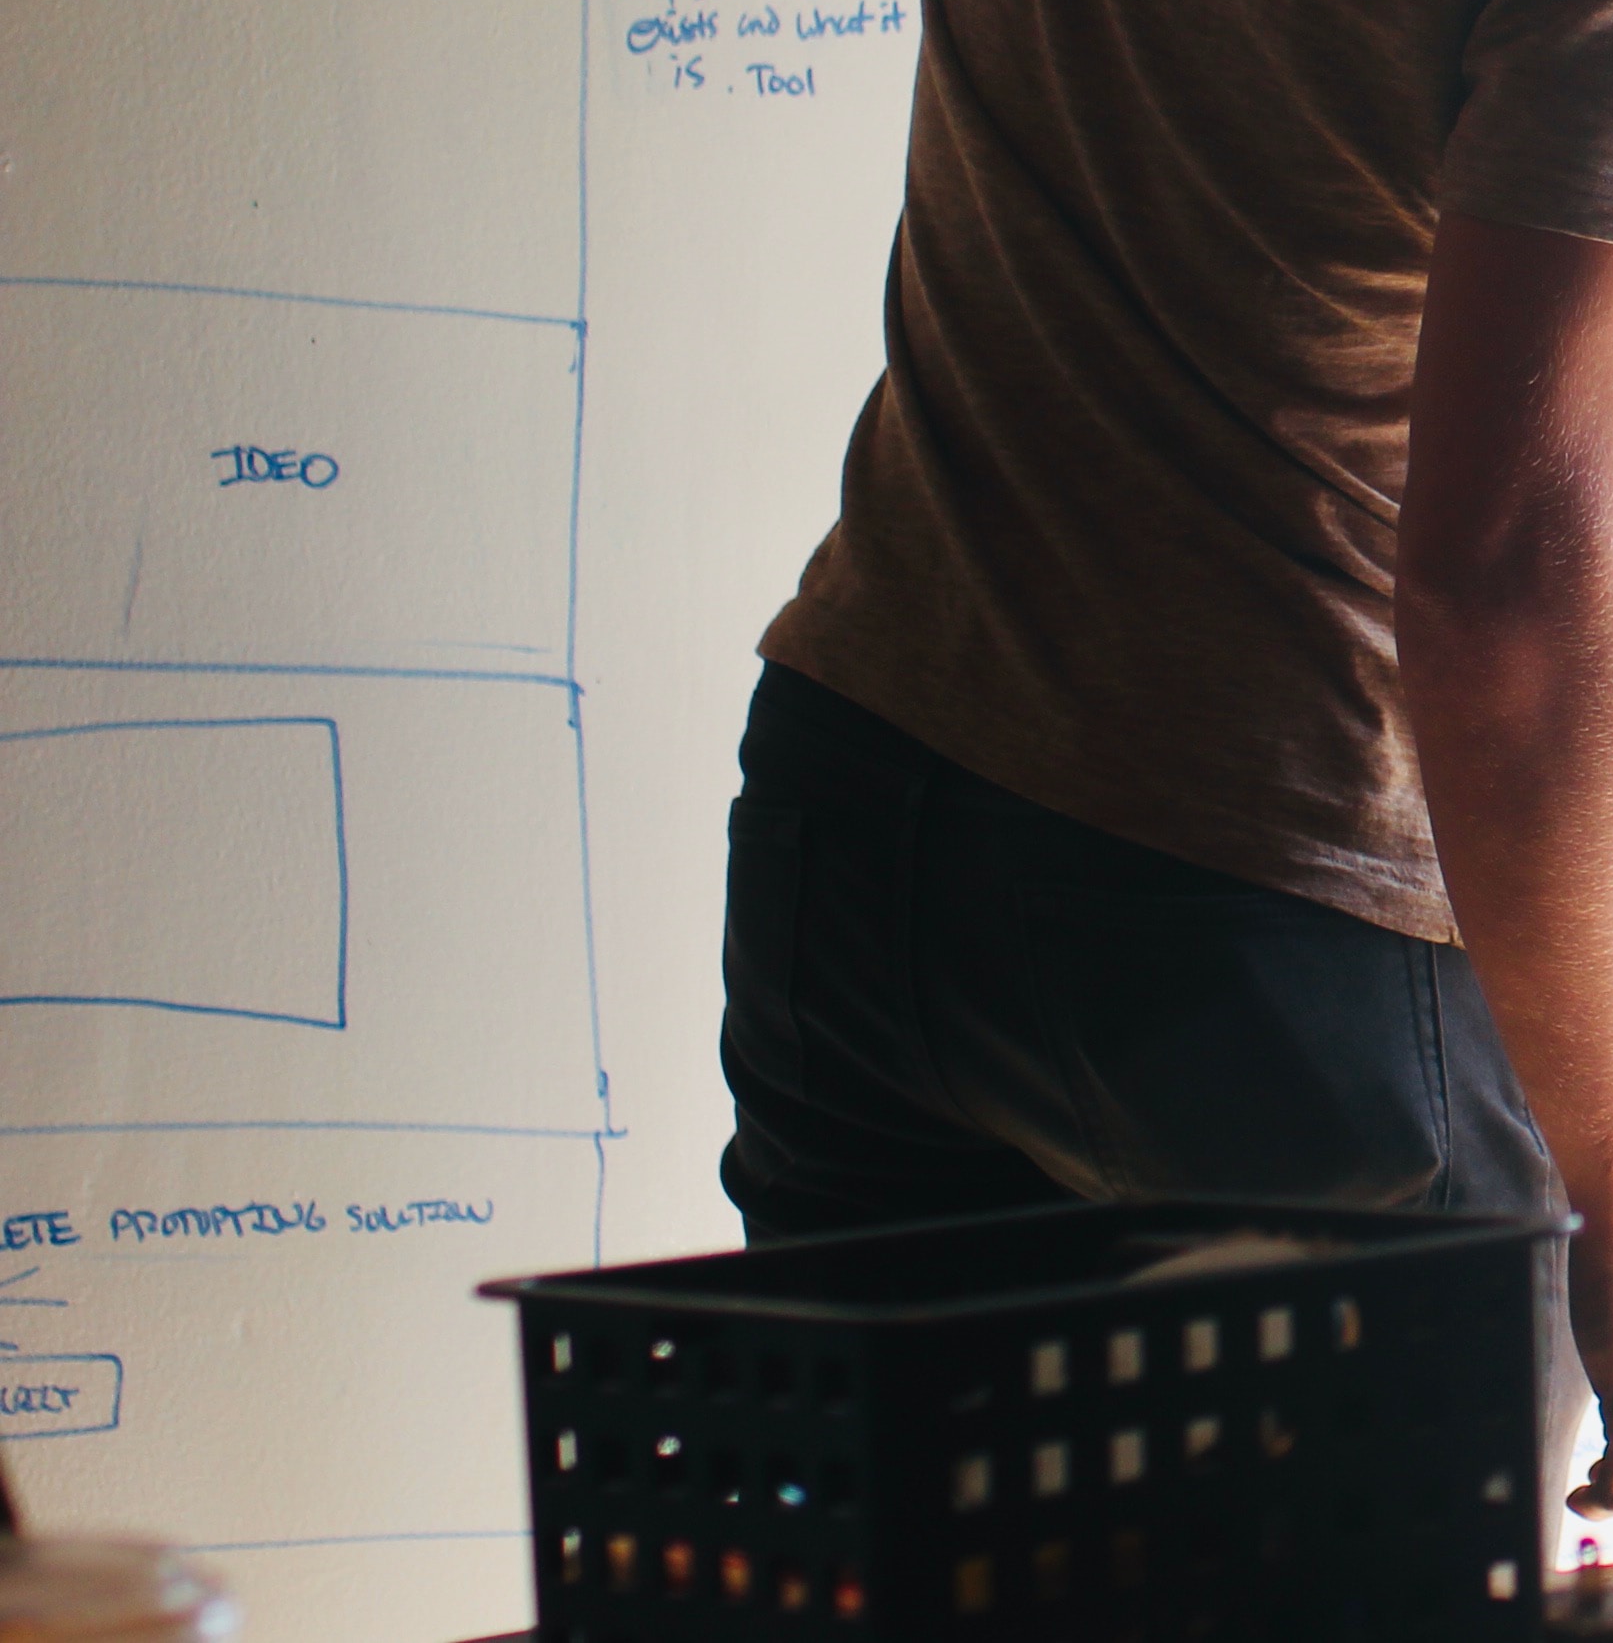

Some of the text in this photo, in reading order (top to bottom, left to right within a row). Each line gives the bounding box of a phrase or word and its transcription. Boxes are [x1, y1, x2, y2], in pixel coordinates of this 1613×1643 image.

[626, 8, 720, 55] exists
[736, 5, 781, 38] and
[879, 0, 906, 33] it
[668, 52, 817, 98] is Tool
[210, 445, 340, 490] IDEO
[348, 1199, 495, 1233] SOLUTION
